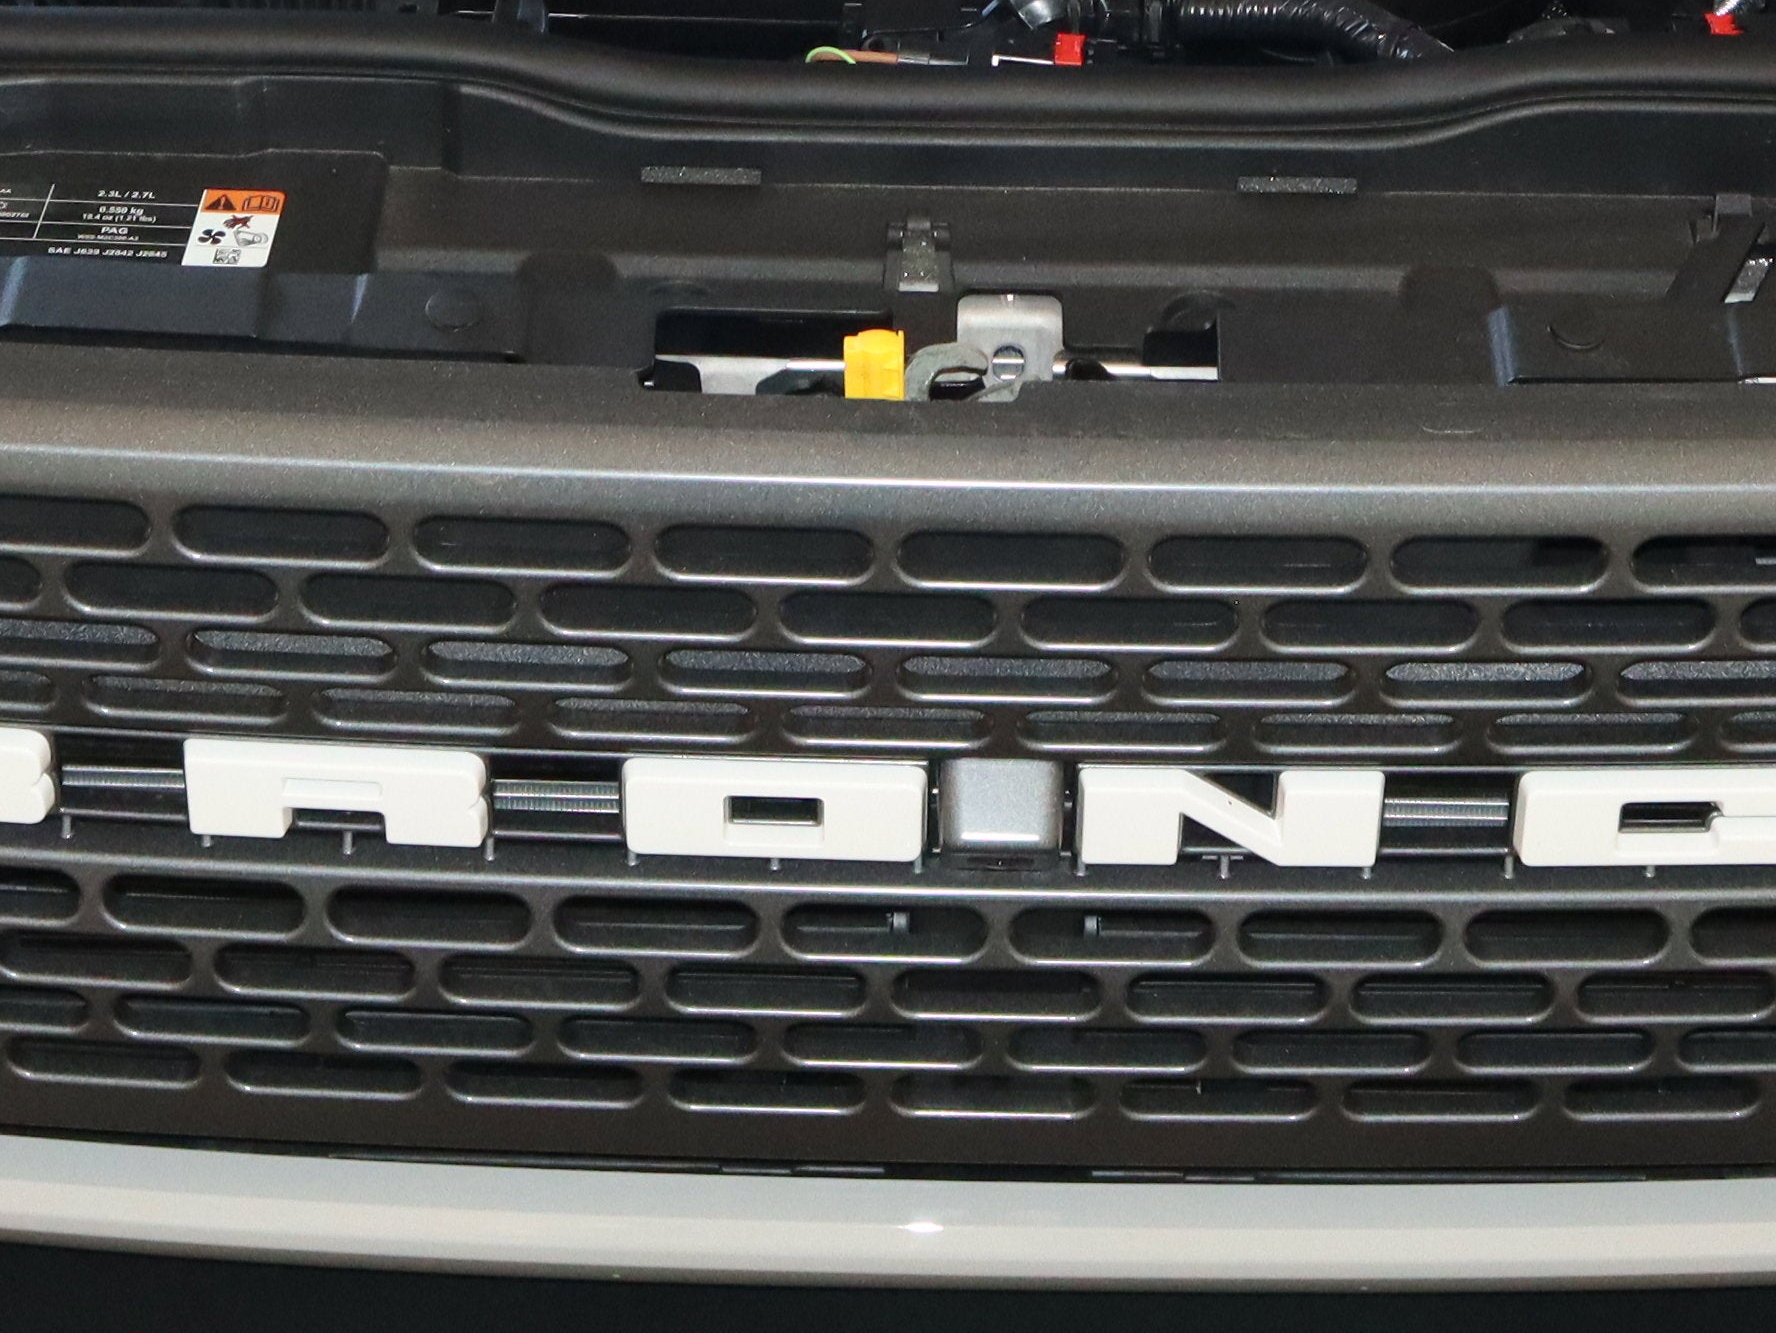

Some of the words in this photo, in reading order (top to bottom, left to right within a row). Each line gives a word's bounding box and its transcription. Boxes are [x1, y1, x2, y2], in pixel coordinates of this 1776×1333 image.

[97, 190, 122, 199] 2.3L
[131, 191, 156, 200] 2.7L
[129, 206, 144, 217] kg
[101, 226, 129, 235] PAG
[48, 247, 72, 255] SAE
